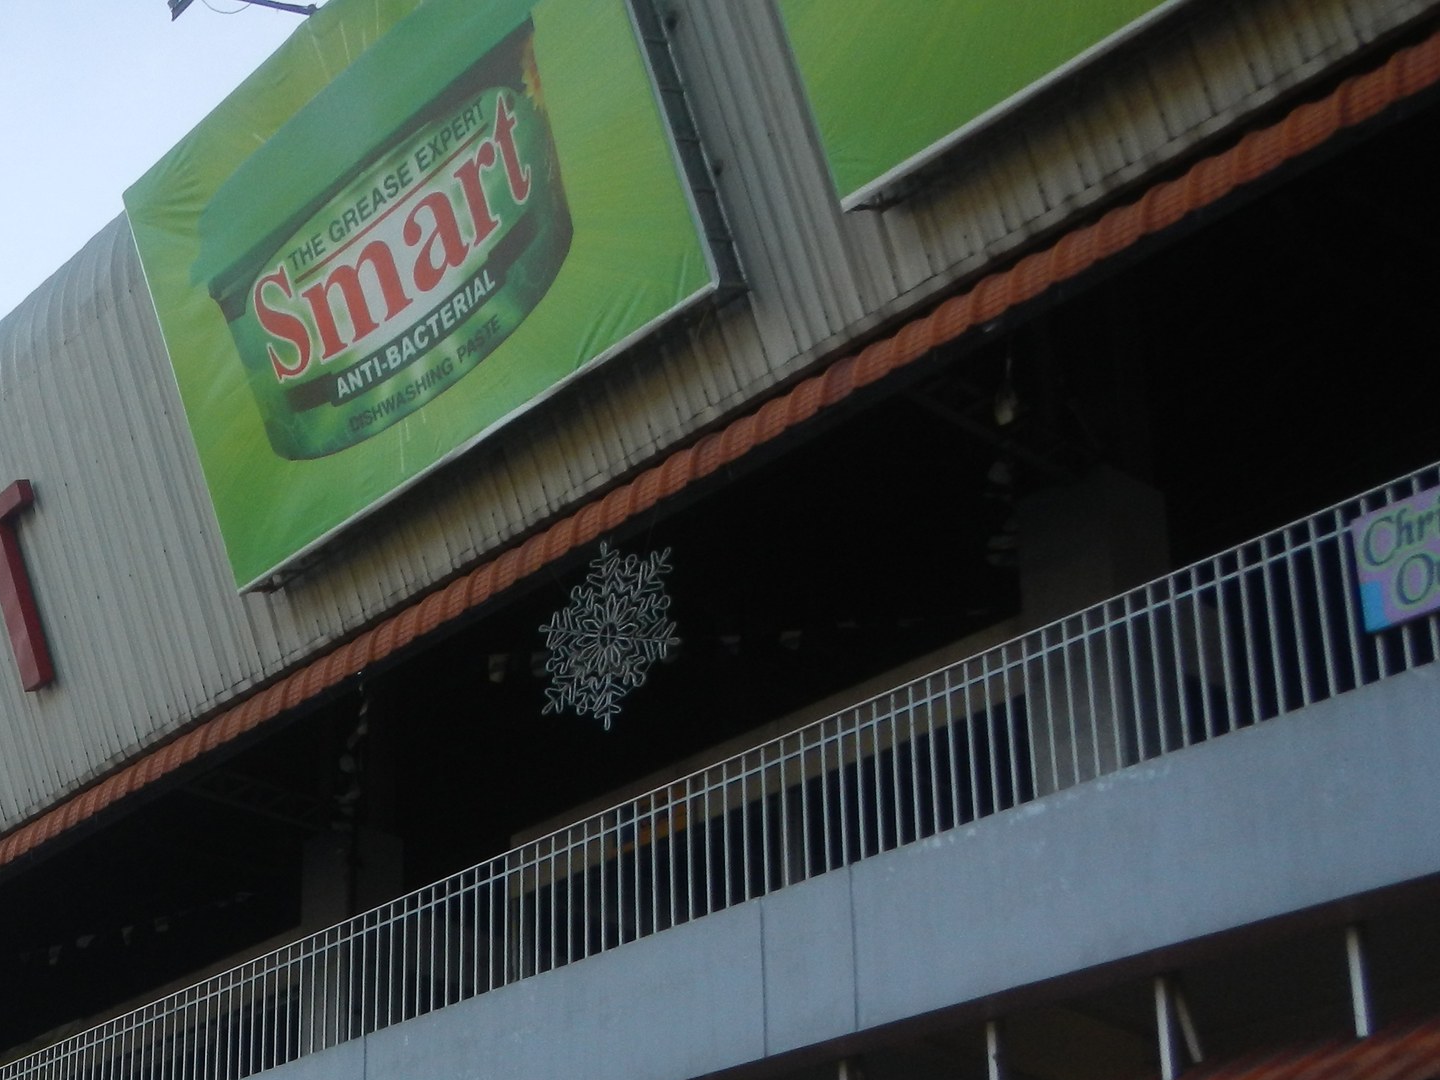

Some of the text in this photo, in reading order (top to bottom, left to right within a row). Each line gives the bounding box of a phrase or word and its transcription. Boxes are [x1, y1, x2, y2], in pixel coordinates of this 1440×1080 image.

[253, 91, 532, 384] Smart
[287, 100, 486, 272] THE GREASE EXPERT
[336, 269, 497, 399] ANTI-BACTERIAL
[348, 314, 502, 432] DISHWASHING PASTE
[1396, 552, 1440, 605] O
